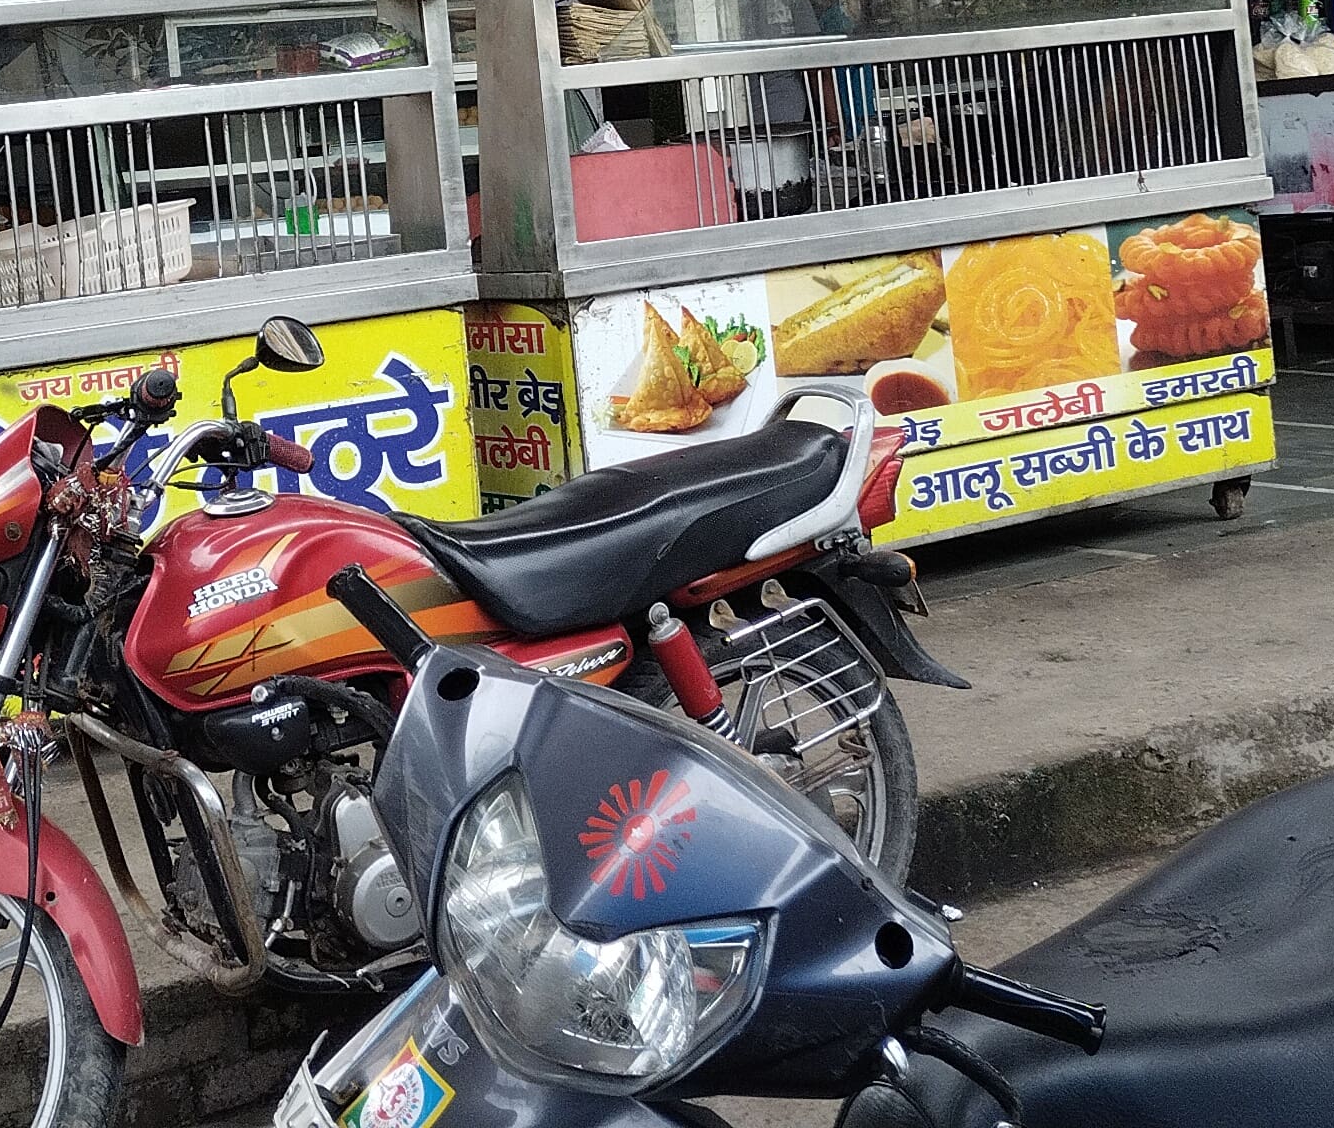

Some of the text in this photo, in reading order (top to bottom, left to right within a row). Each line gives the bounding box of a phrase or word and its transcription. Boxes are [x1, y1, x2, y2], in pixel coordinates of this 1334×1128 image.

[468, 313, 545, 354] मोसा
[18, 375, 71, 402] जय
[79, 364, 145, 393] माता
[978, 382, 1107, 433] जलेबी
[1141, 356, 1258, 407] इमरती
[910, 410, 1251, 510] आलू सब्जी के साथ
[188, 578, 278, 618] HONDA
[193, 567, 266, 602] HERO
[252, 702, 293, 723] POWER
[262, 707, 300, 727] START
